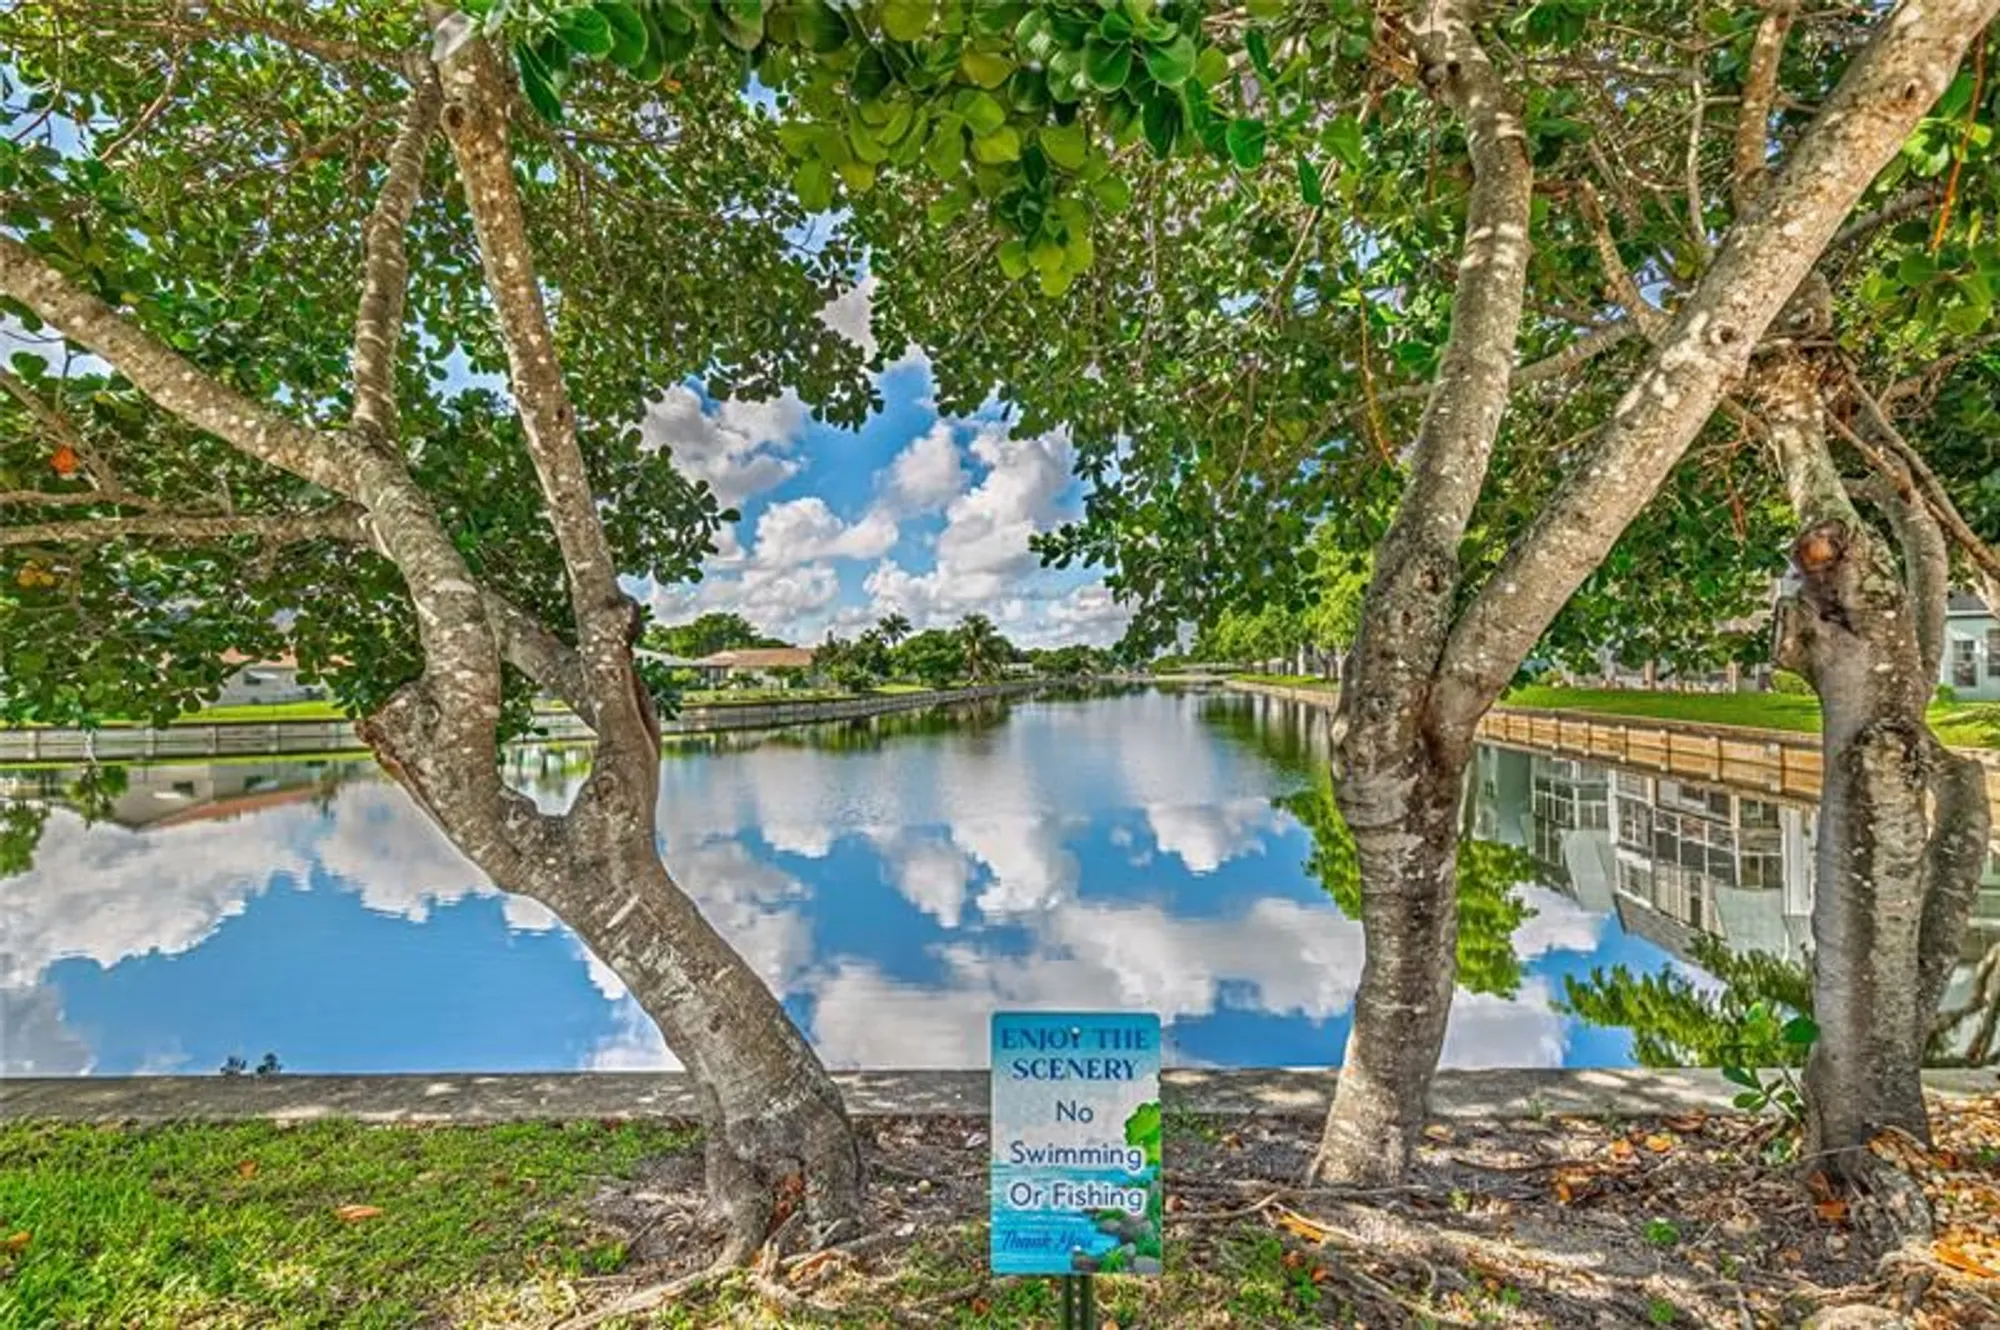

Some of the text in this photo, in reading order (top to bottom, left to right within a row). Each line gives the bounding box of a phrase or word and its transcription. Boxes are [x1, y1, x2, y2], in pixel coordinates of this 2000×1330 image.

[1001, 1027, 1150, 1051] ENJOY THE
[1012, 1057, 1138, 1081] SCENERY
[1056, 1100, 1094, 1124] No
[1010, 1140, 1142, 1171] Swimming
[1010, 1182, 1142, 1211] Or Fishing
